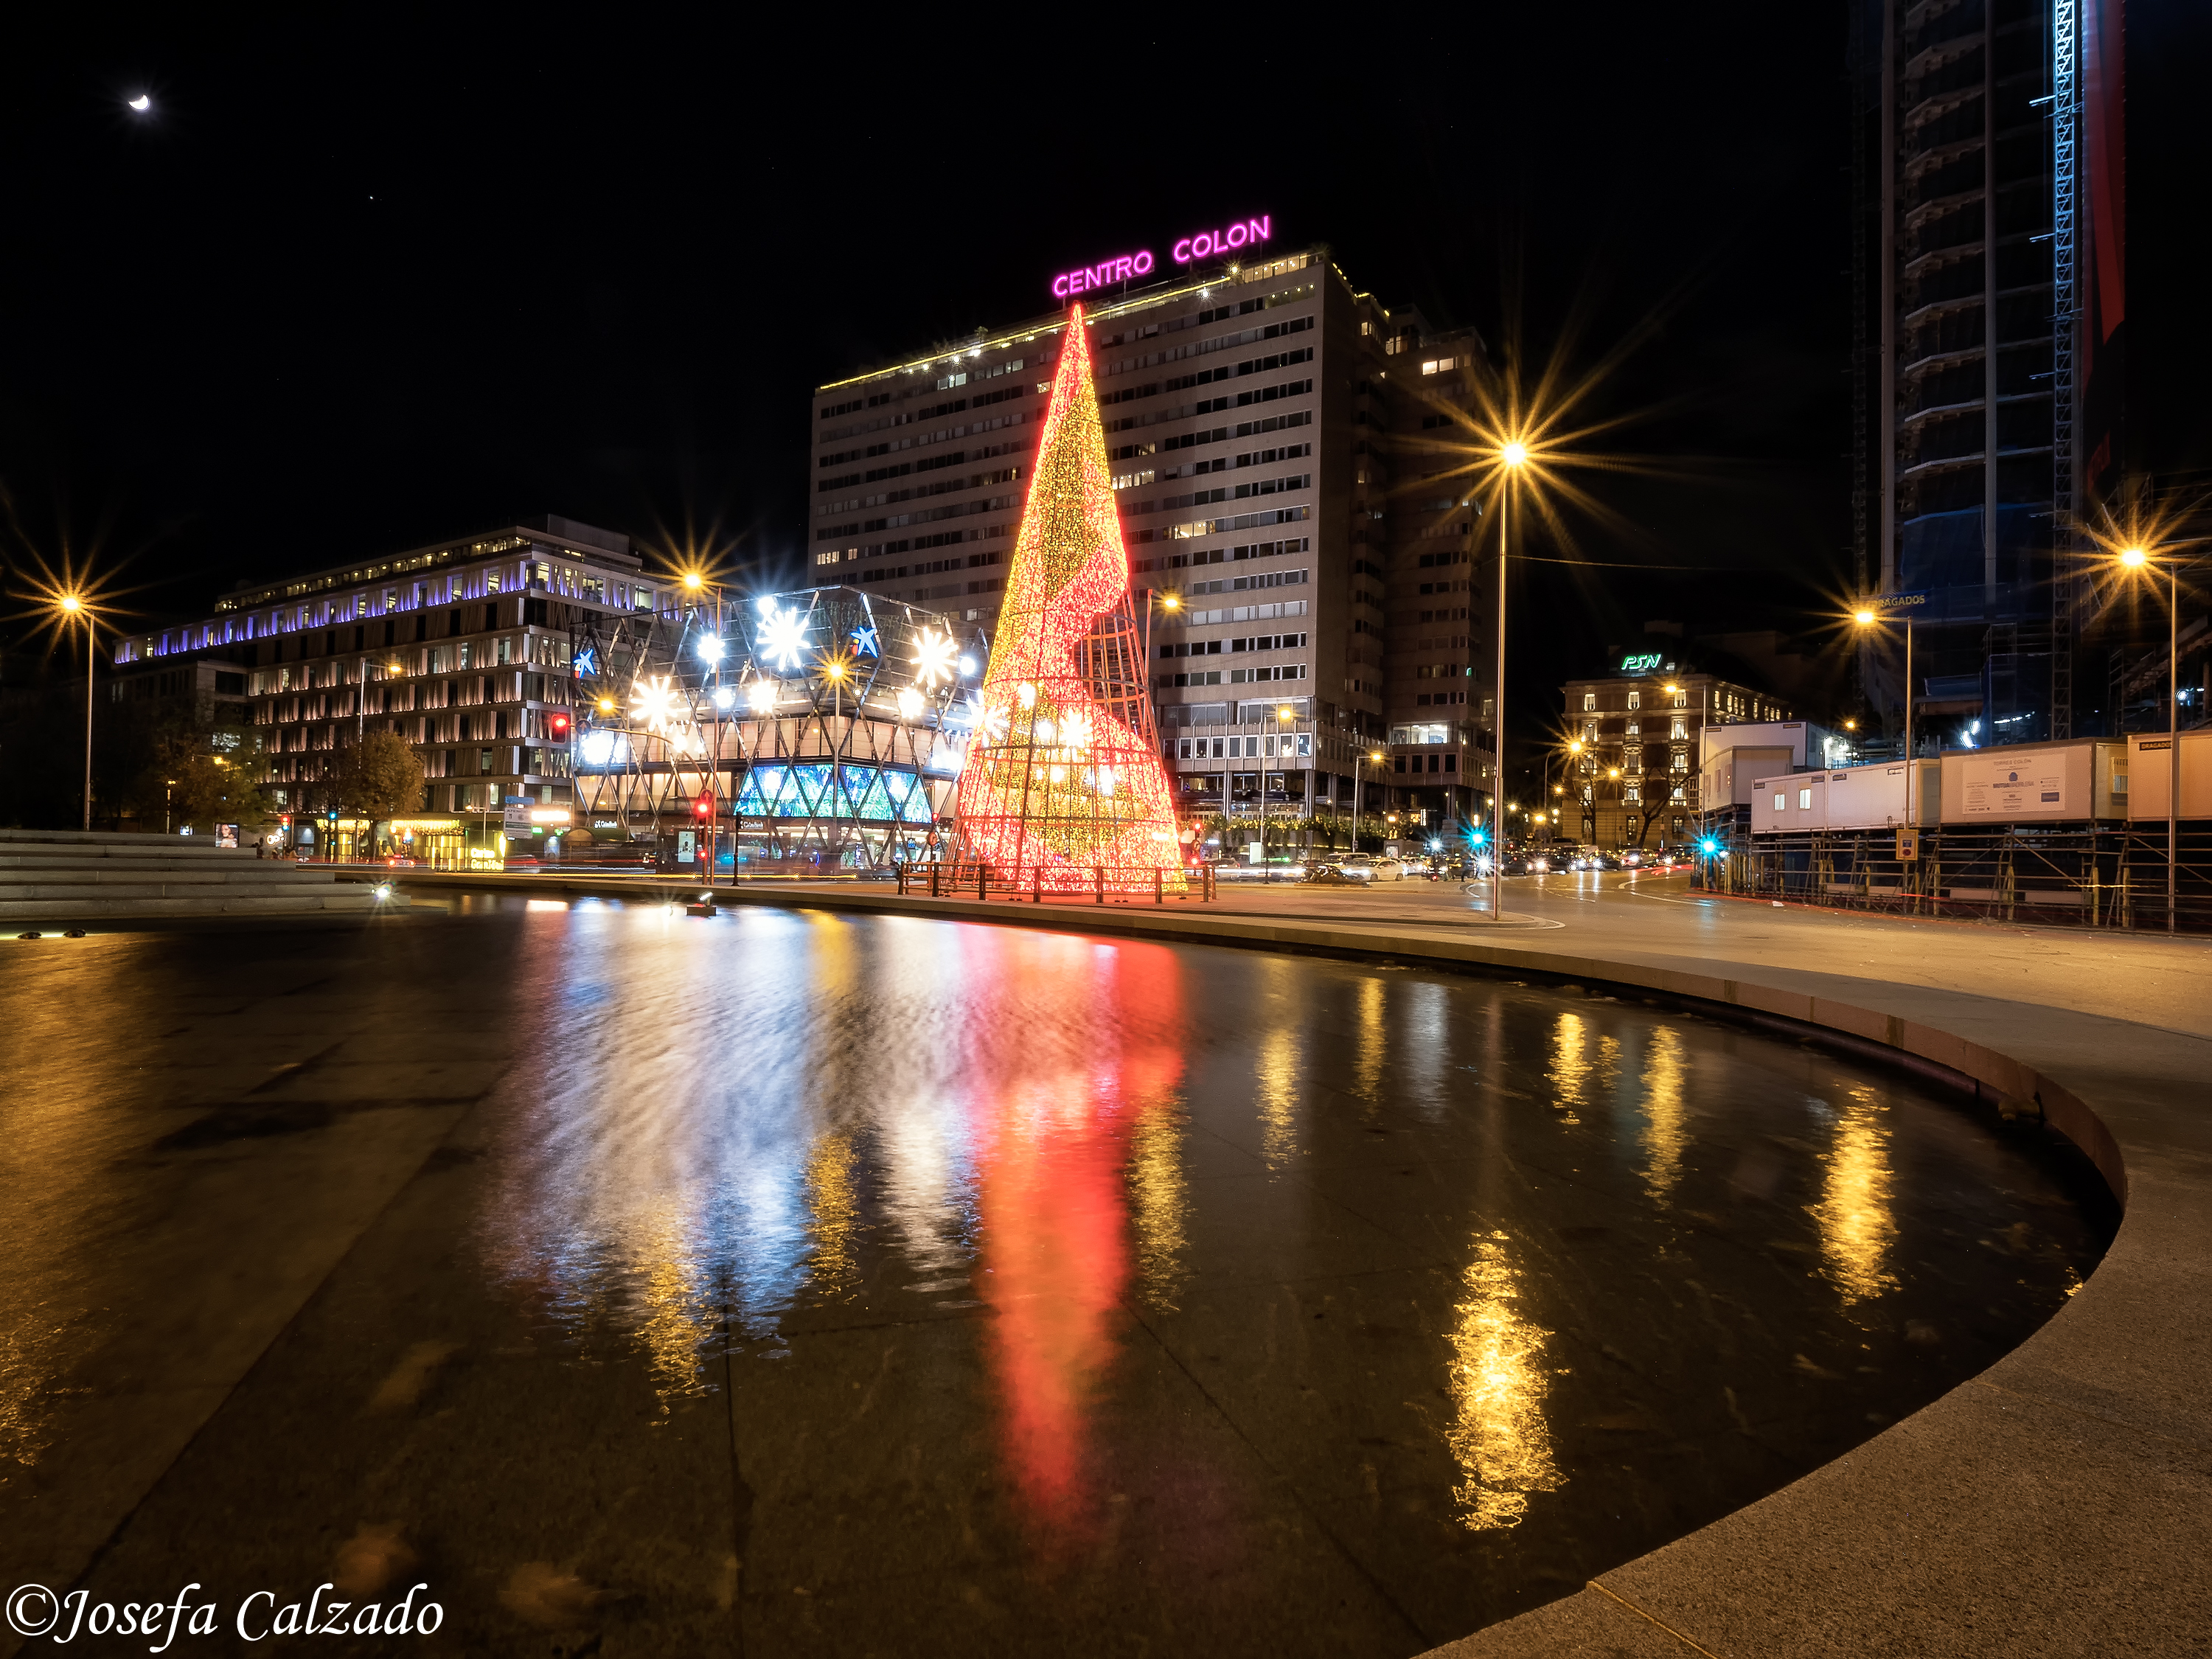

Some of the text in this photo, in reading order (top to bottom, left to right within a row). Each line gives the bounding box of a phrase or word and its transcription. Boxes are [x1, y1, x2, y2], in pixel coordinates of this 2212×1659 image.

[1052, 215, 1270, 298] CENTRO COLON
[1621, 653, 1661, 670] PSN
